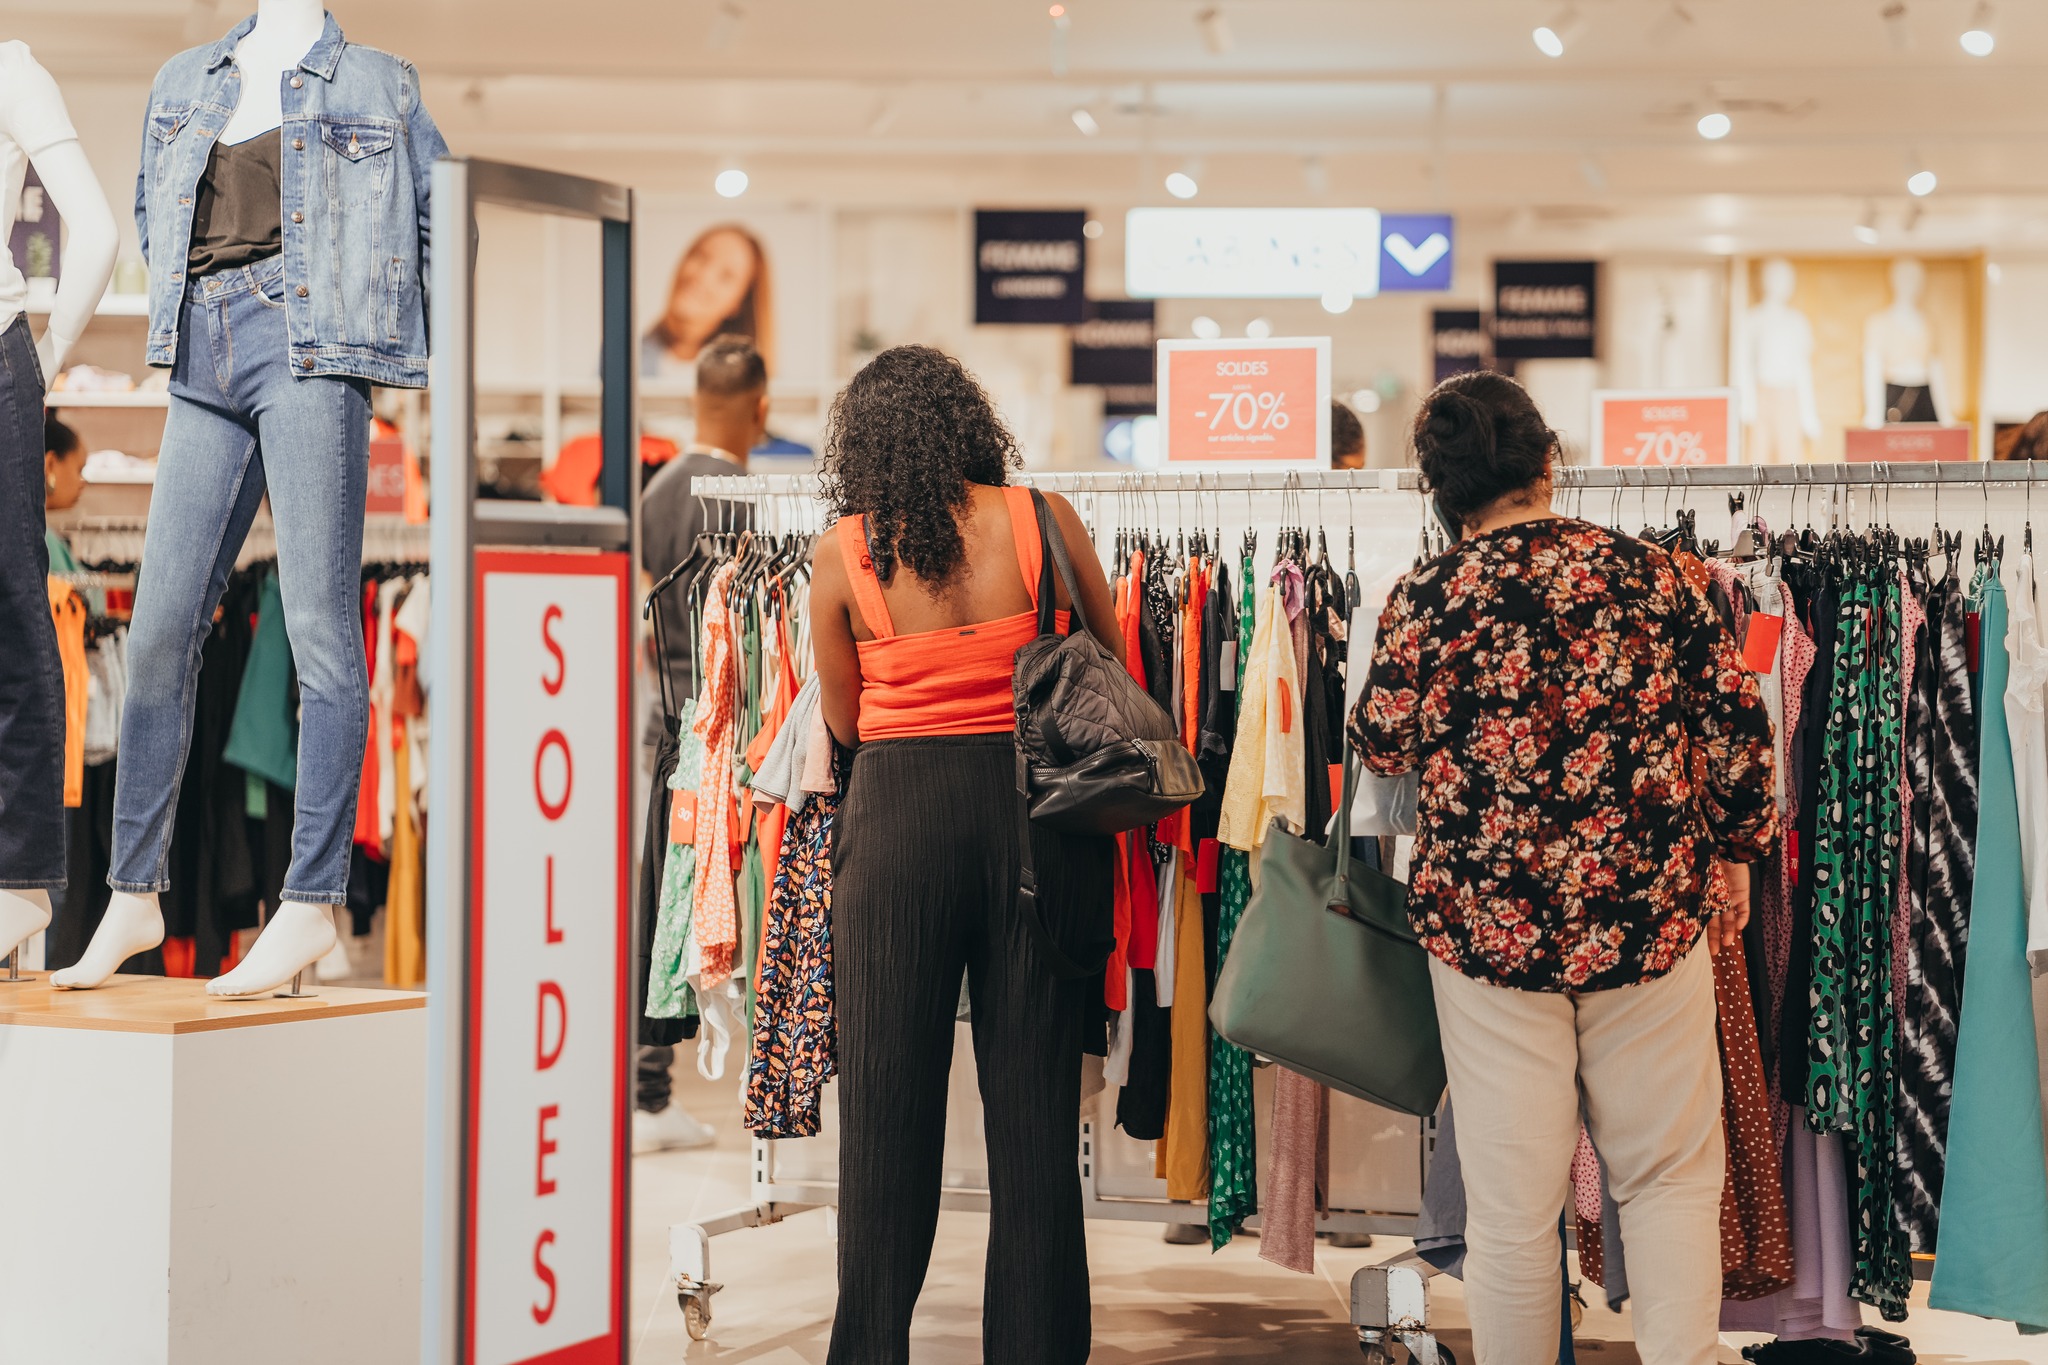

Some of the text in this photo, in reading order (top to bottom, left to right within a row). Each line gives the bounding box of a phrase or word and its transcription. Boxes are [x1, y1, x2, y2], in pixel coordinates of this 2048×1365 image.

[1216, 361, 1269, 376] SOLDES
[1642, 406, 1688, 421] SOLDES
[1623, 430, 1707, 465] -70%
[530, 603, 573, 1325] SOLDES
